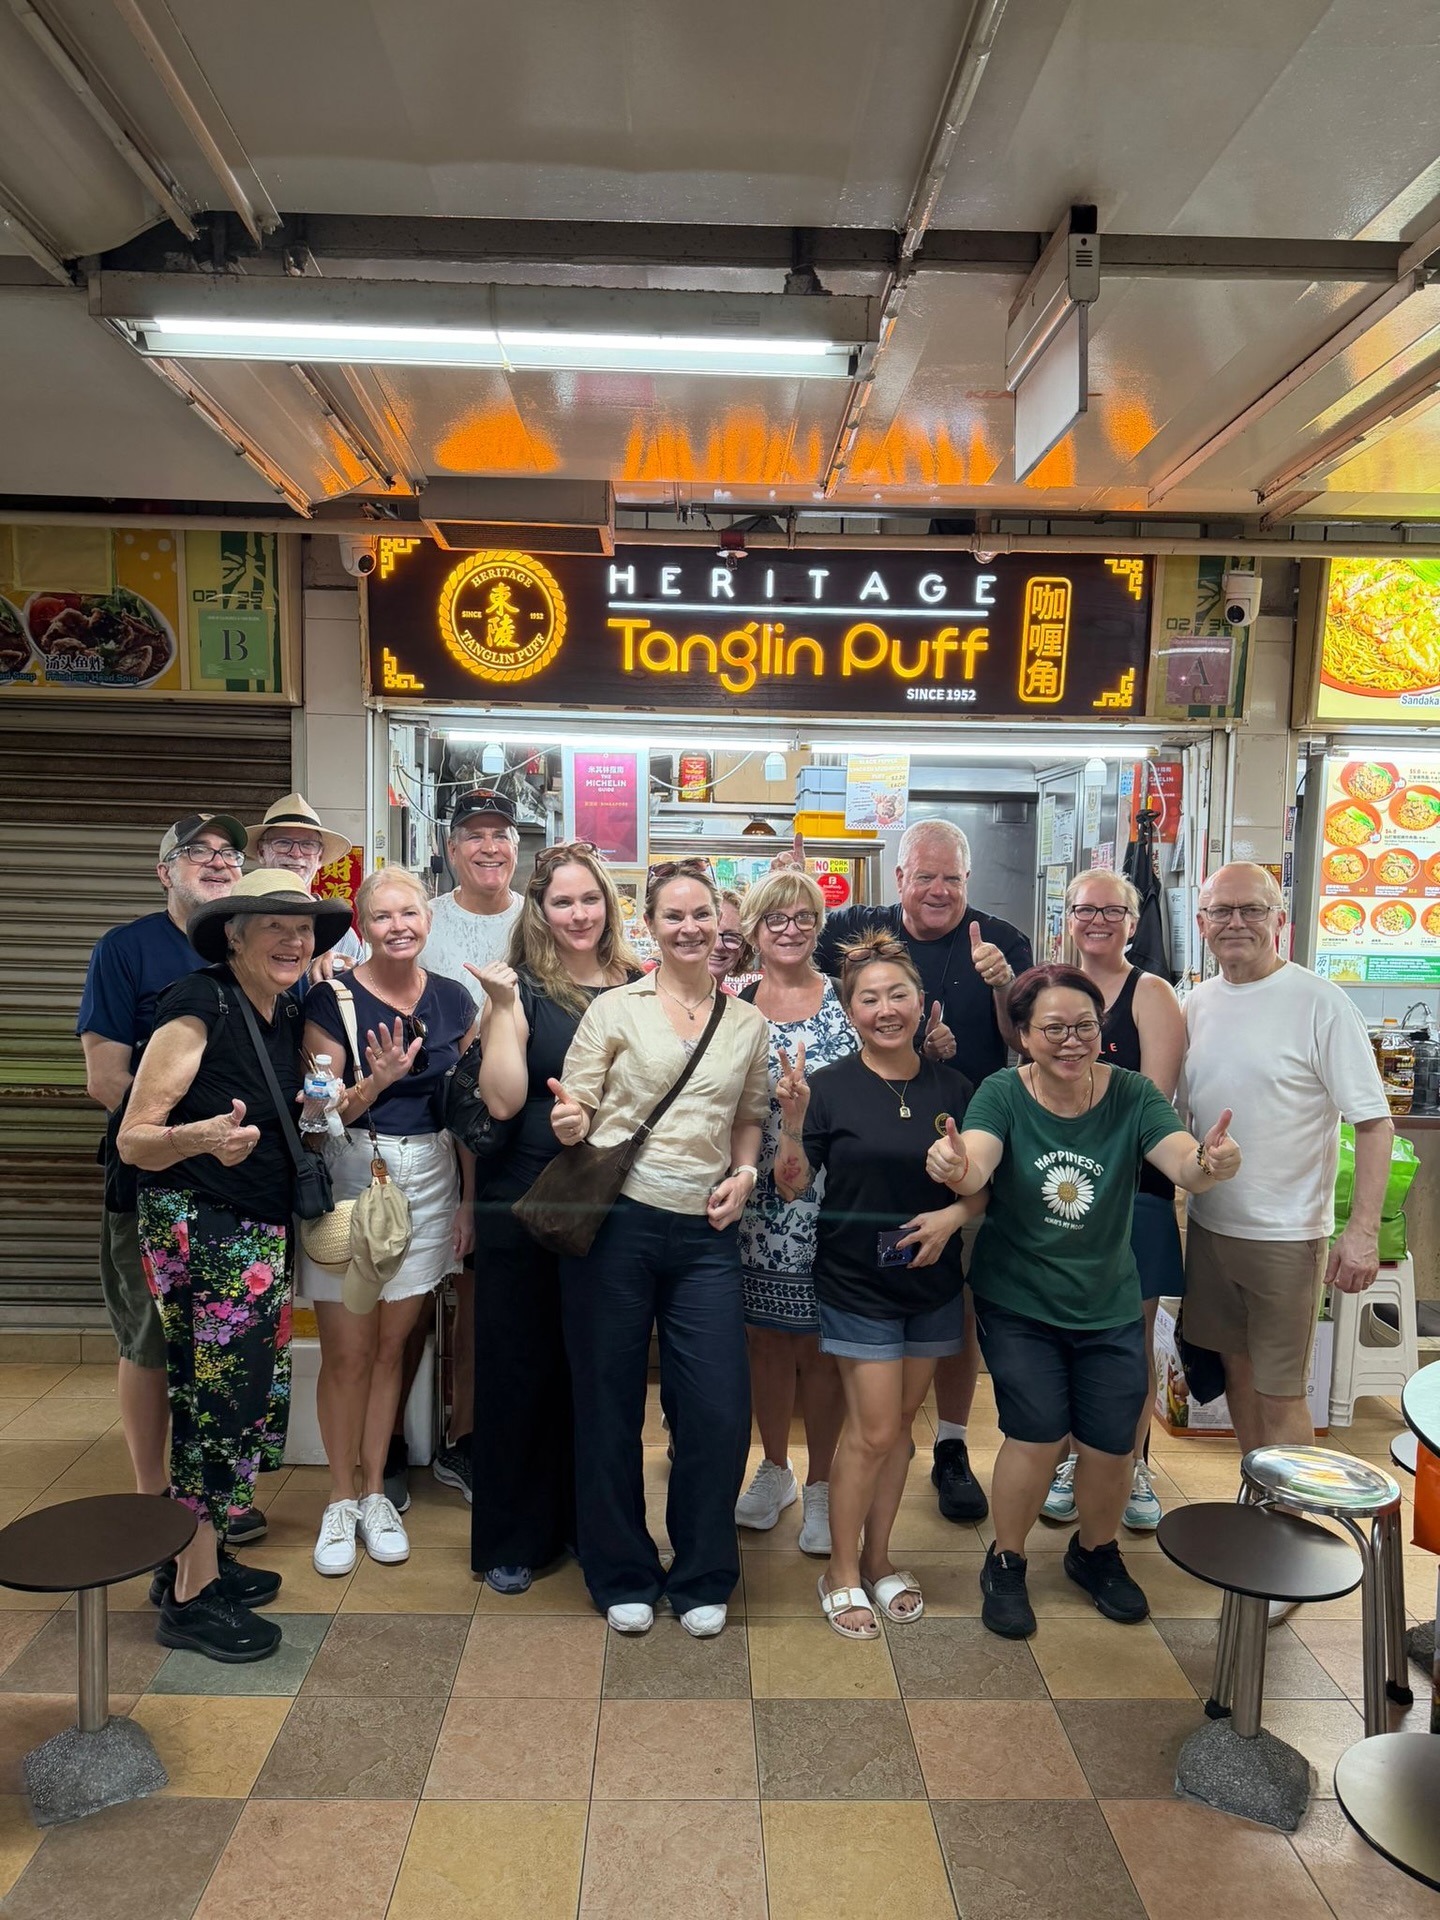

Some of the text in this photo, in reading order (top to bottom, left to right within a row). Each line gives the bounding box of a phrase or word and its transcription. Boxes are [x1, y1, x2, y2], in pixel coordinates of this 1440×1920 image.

[471, 568, 533, 588] HERITAGE
[609, 564, 997, 603] HERITAGE
[461, 610, 482, 619] SINCE
[530, 612, 544, 620] 1952
[222, 629, 248, 661] B
[460, 629, 545, 664] TANGLIN PUFF
[1026, 585, 1065, 695] 咖喱角
[607, 618, 990, 692] Tanglin Puff
[118, 673, 140, 683] Soup
[1180, 654, 1214, 687] A
[906, 688, 977, 701] SINCE 1952
[585, 779, 627, 787] MICHELIN
[815, 860, 829, 871] NO
[1033, 1150, 1105, 1177] HAPPINESS
